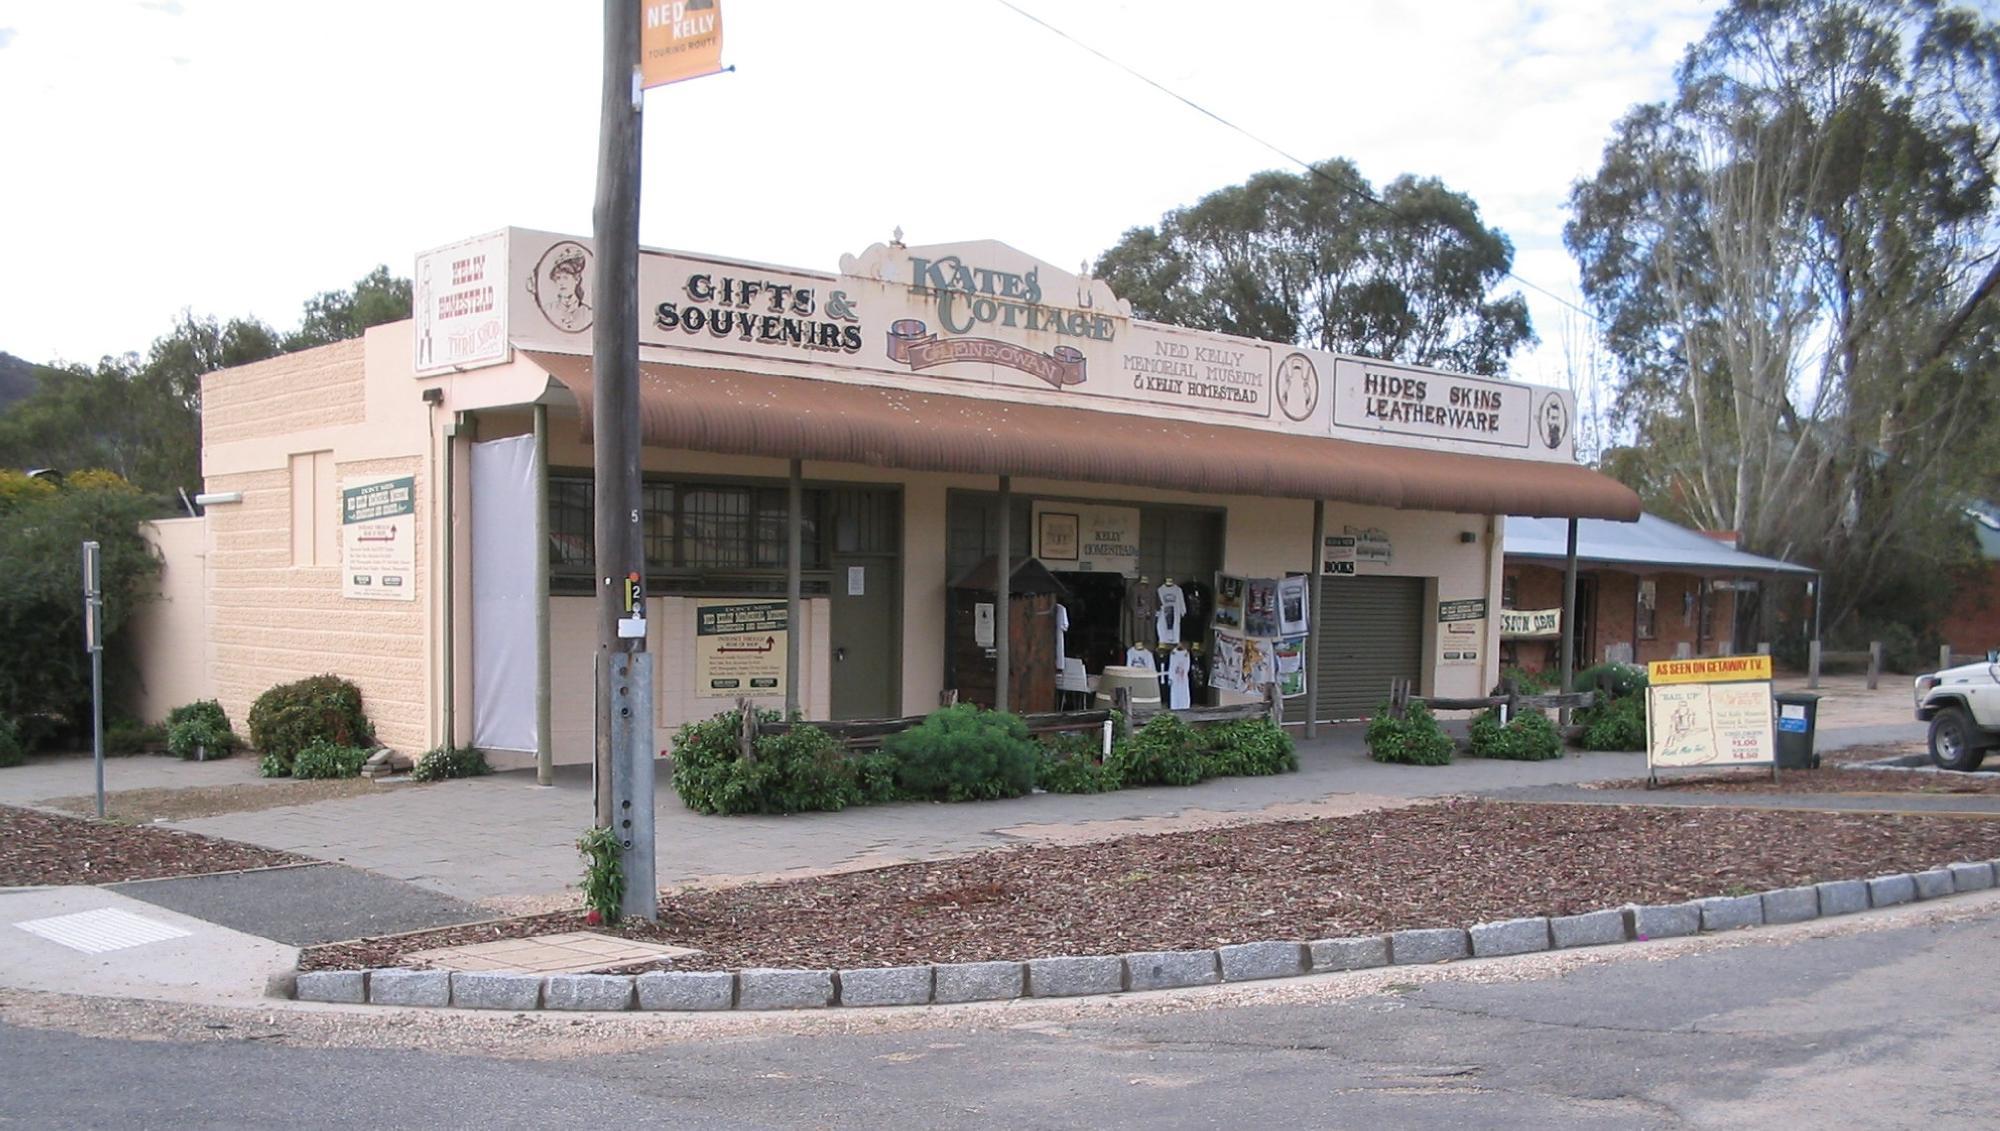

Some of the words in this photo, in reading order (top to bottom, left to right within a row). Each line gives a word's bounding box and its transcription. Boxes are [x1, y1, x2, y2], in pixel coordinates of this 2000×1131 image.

[648, 2, 684, 29] NED
[673, 14, 715, 40] KELLY
[648, 43, 686, 58] TOURING
[688, 36, 717, 50] ROUTE
[452, 254, 486, 286] KELLY
[908, 254, 1042, 305] KATES
[438, 285, 494, 320] HOMESTEAD
[686, 273, 817, 315] GIFTS
[824, 289, 860, 321] &
[656, 301, 864, 353] SOUVENIRS
[937, 289, 1116, 342] COTTAGE
[920, 340, 1059, 381] GLENROWAN
[1156, 340, 1192, 359] NED
[1195, 347, 1245, 368] KELLY
[1123, 354, 1198, 380] MEMORIAL
[1206, 366, 1263, 387] MUSEUM
[1146, 376, 1183, 396] KELLY
[1187, 383, 1259, 405] HOMESTEAD
[1365, 372, 1428, 400] HIDES
[1449, 385, 1503, 409] SKINS
[1366, 396, 1500, 431] LEATHERWARE
[631, 510, 639, 523] 5
[632, 586, 641, 599] 2
[1656, 664, 1669, 676] AS
[1669, 662, 1692, 675] SEEN
[1692, 661, 1706, 674] ON
[1707, 659, 1748, 673] GETAWAY
